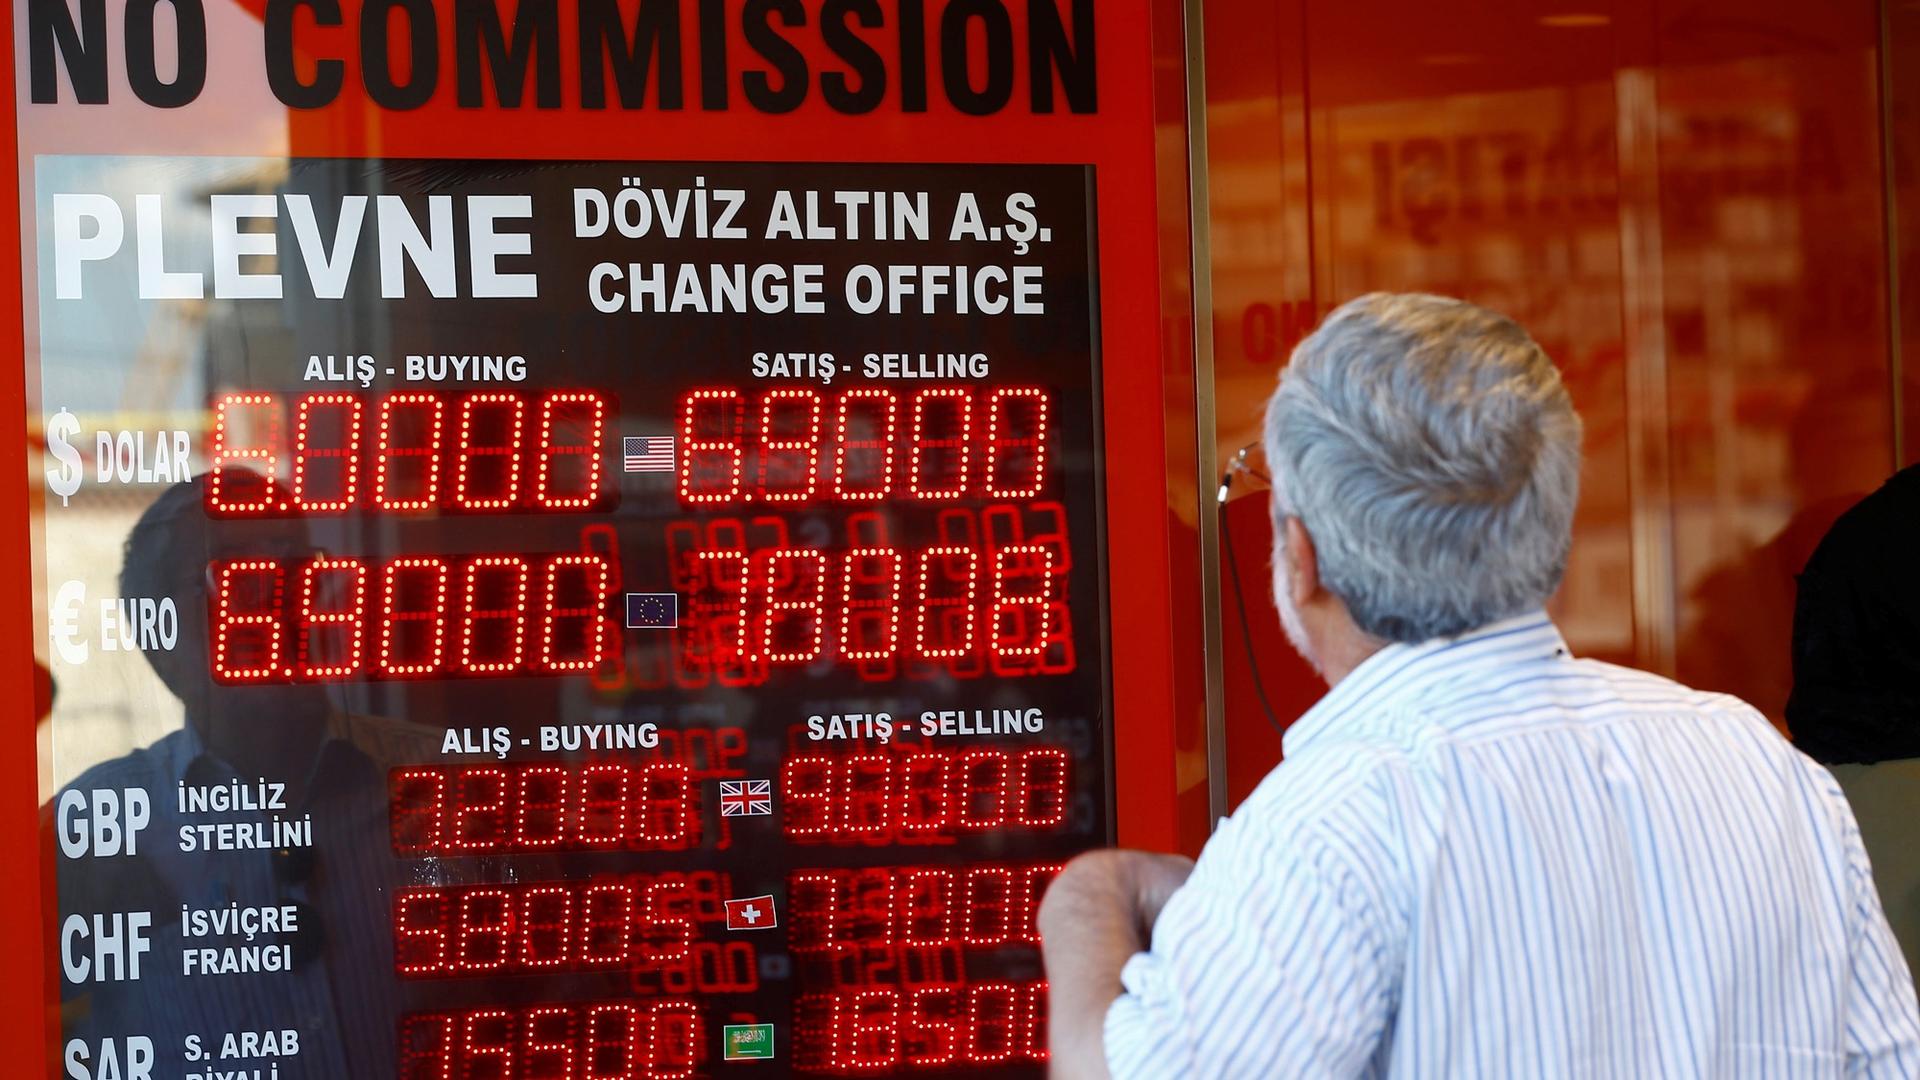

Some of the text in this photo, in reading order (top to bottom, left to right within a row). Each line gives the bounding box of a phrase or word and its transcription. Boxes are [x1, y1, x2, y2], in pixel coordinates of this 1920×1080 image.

[30, 0, 1098, 116] NO COMMISSION
[53, 194, 538, 300] PLEVNE
[573, 177, 1052, 255] DÖVİZ ALTIN A.Ş.
[588, 262, 1044, 315] CHANGE OFFICE
[303, 355, 376, 388] ALIŞ
[405, 355, 527, 382] BUYING
[751, 352, 836, 385] SATIŞ
[863, 353, 989, 378] SELLING
[47, 407, 192, 507] $ DOLAR
[210, 393, 603, 513] 6.0000
[681, 388, 1047, 502] 6.9000
[50, 580, 178, 665] € EURO
[216, 556, 608, 677] 6.9000
[697, 545, 1053, 662] 7.8008
[441, 726, 511, 760] ALIŞ
[540, 722, 659, 751] BUYING
[807, 712, 893, 745] SATIŞ
[920, 708, 1044, 737] SELLING
[57, 787, 151, 859] GBP
[178, 777, 287, 813] İNGİLİZ
[402, 762, 689, 850] 7.2000
[786, 750, 1066, 834] 9.0000
[178, 813, 313, 853] STERLİNİ
[60, 911, 152, 984] CHF
[181, 901, 299, 942] İSVİÇRE
[400, 882, 690, 972] 5.8005
[182, 944, 292, 976] FRANGI
[64, 1035, 155, 1080] SAR
[184, 1029, 300, 1062] S. ARAB
